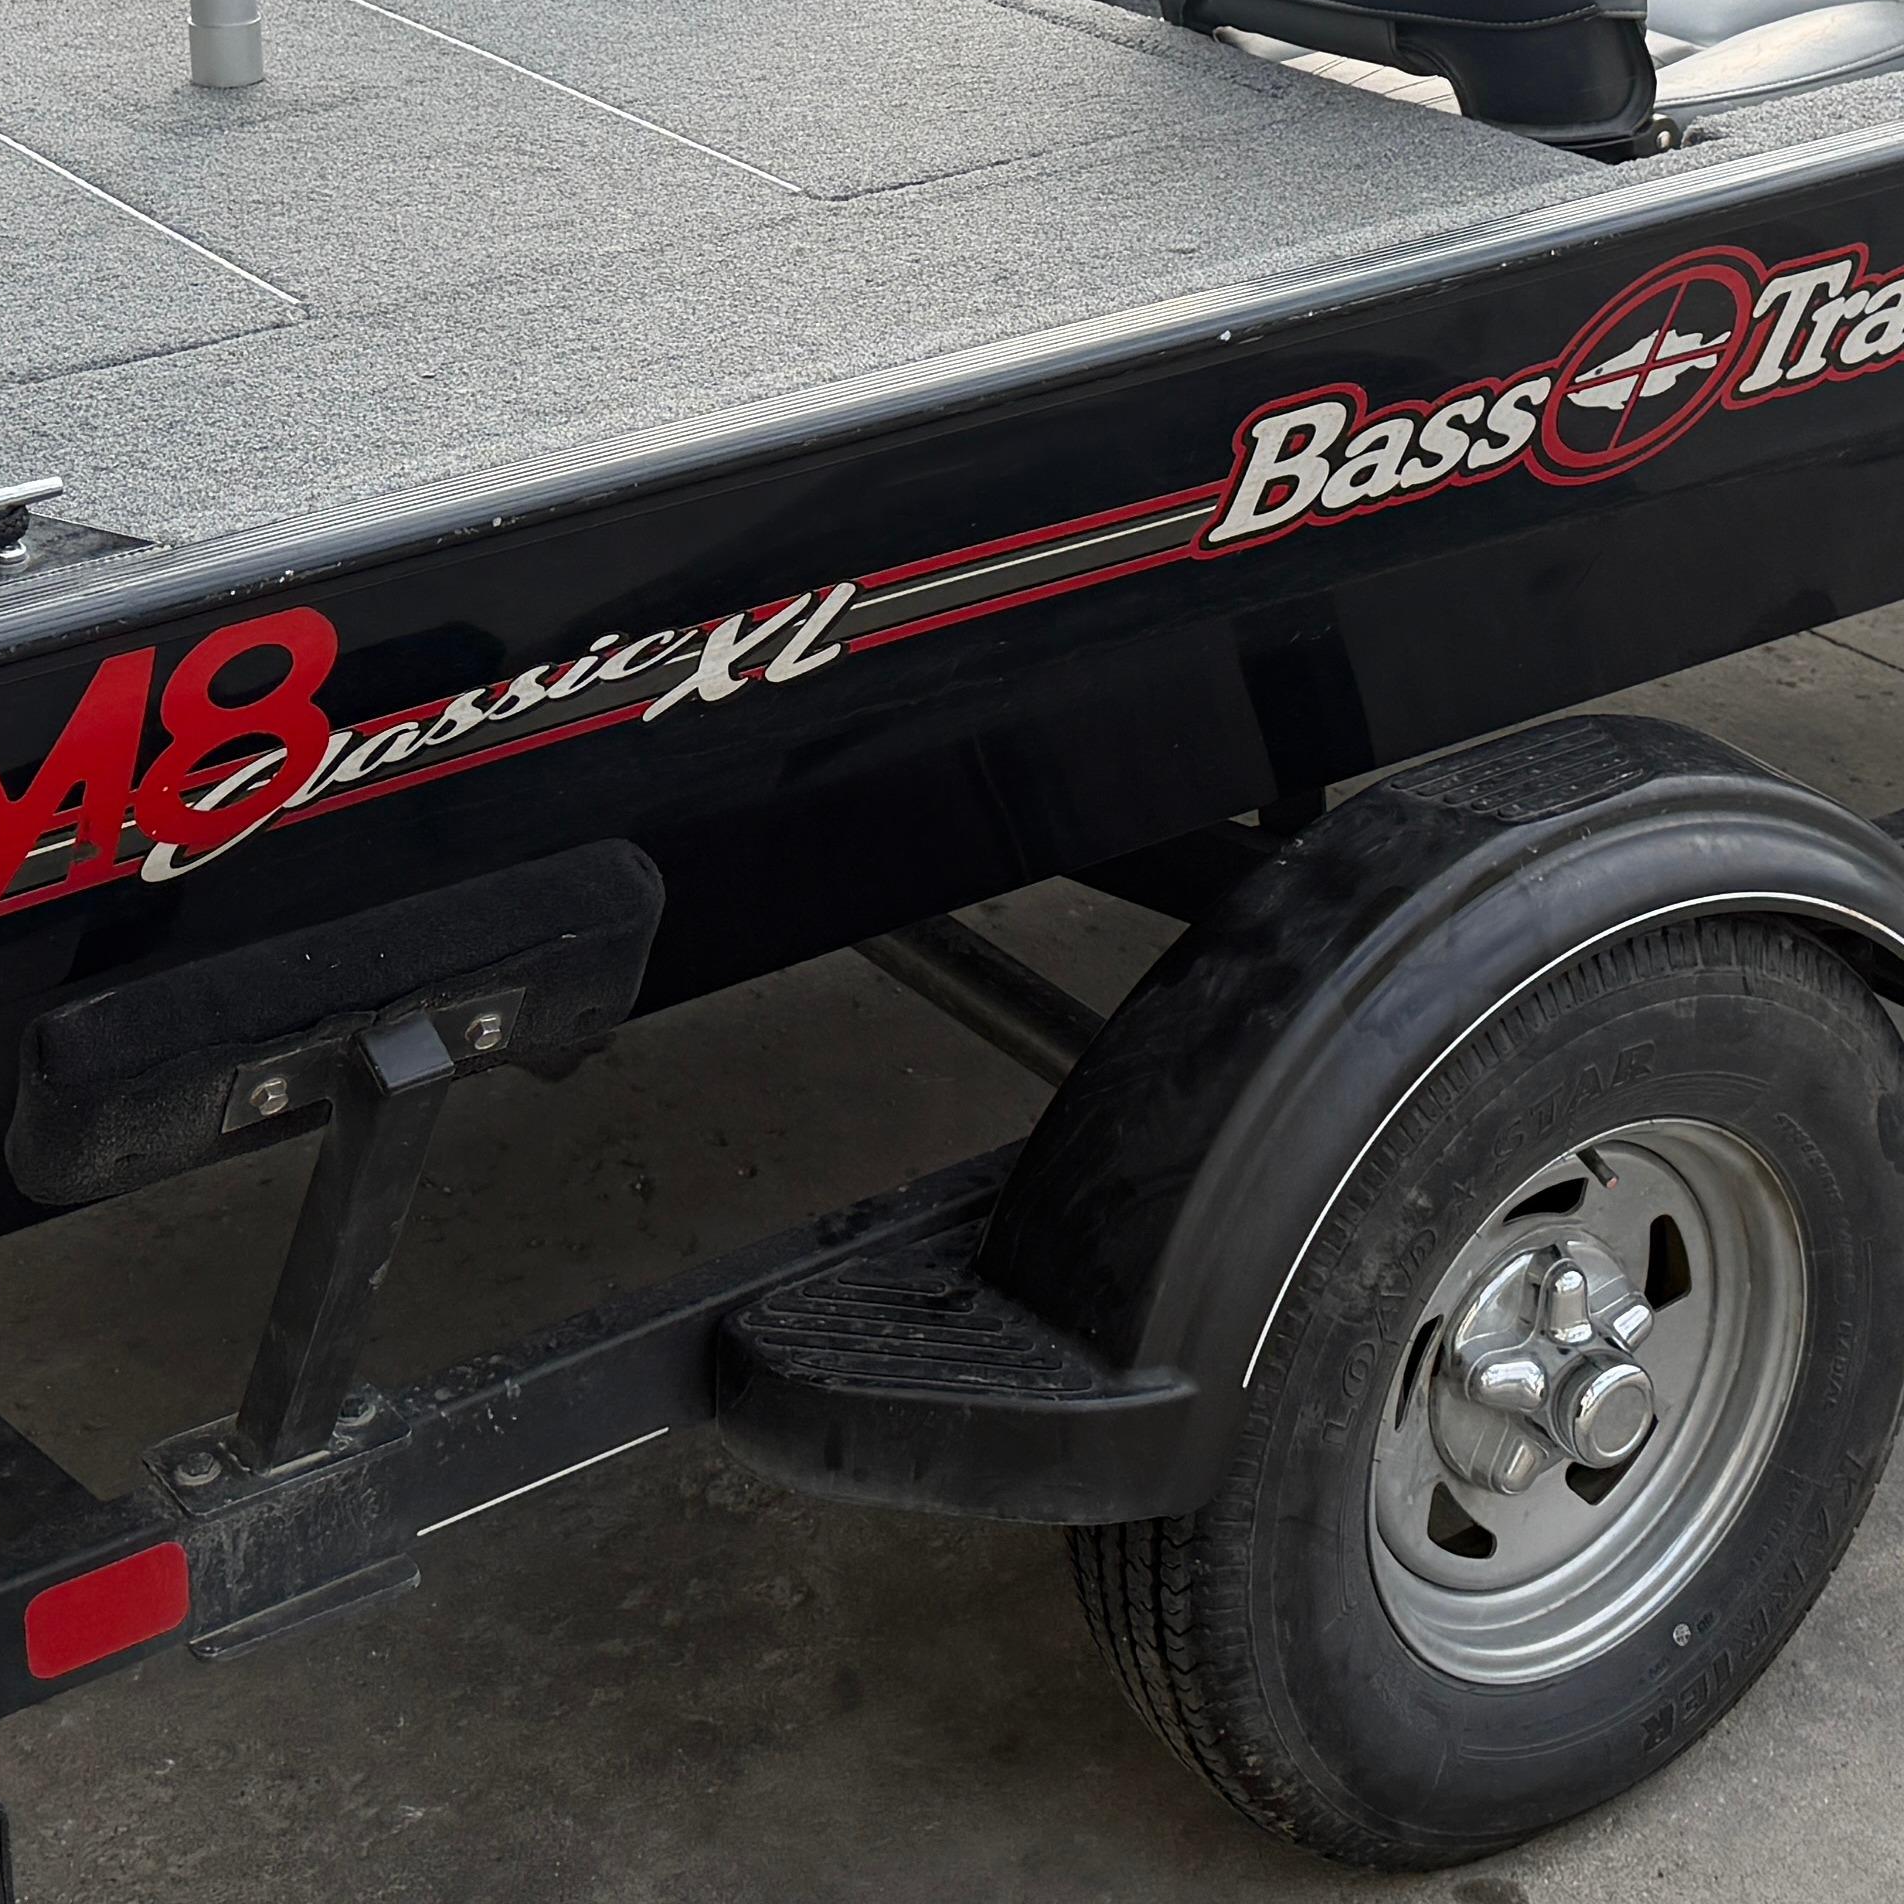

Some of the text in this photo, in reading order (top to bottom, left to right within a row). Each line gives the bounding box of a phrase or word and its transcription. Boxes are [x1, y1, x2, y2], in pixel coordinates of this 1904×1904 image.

[1208, 375, 1552, 543] Bass
[642, 582, 857, 723] XL
[1490, 1039, 1658, 1160] STAR
